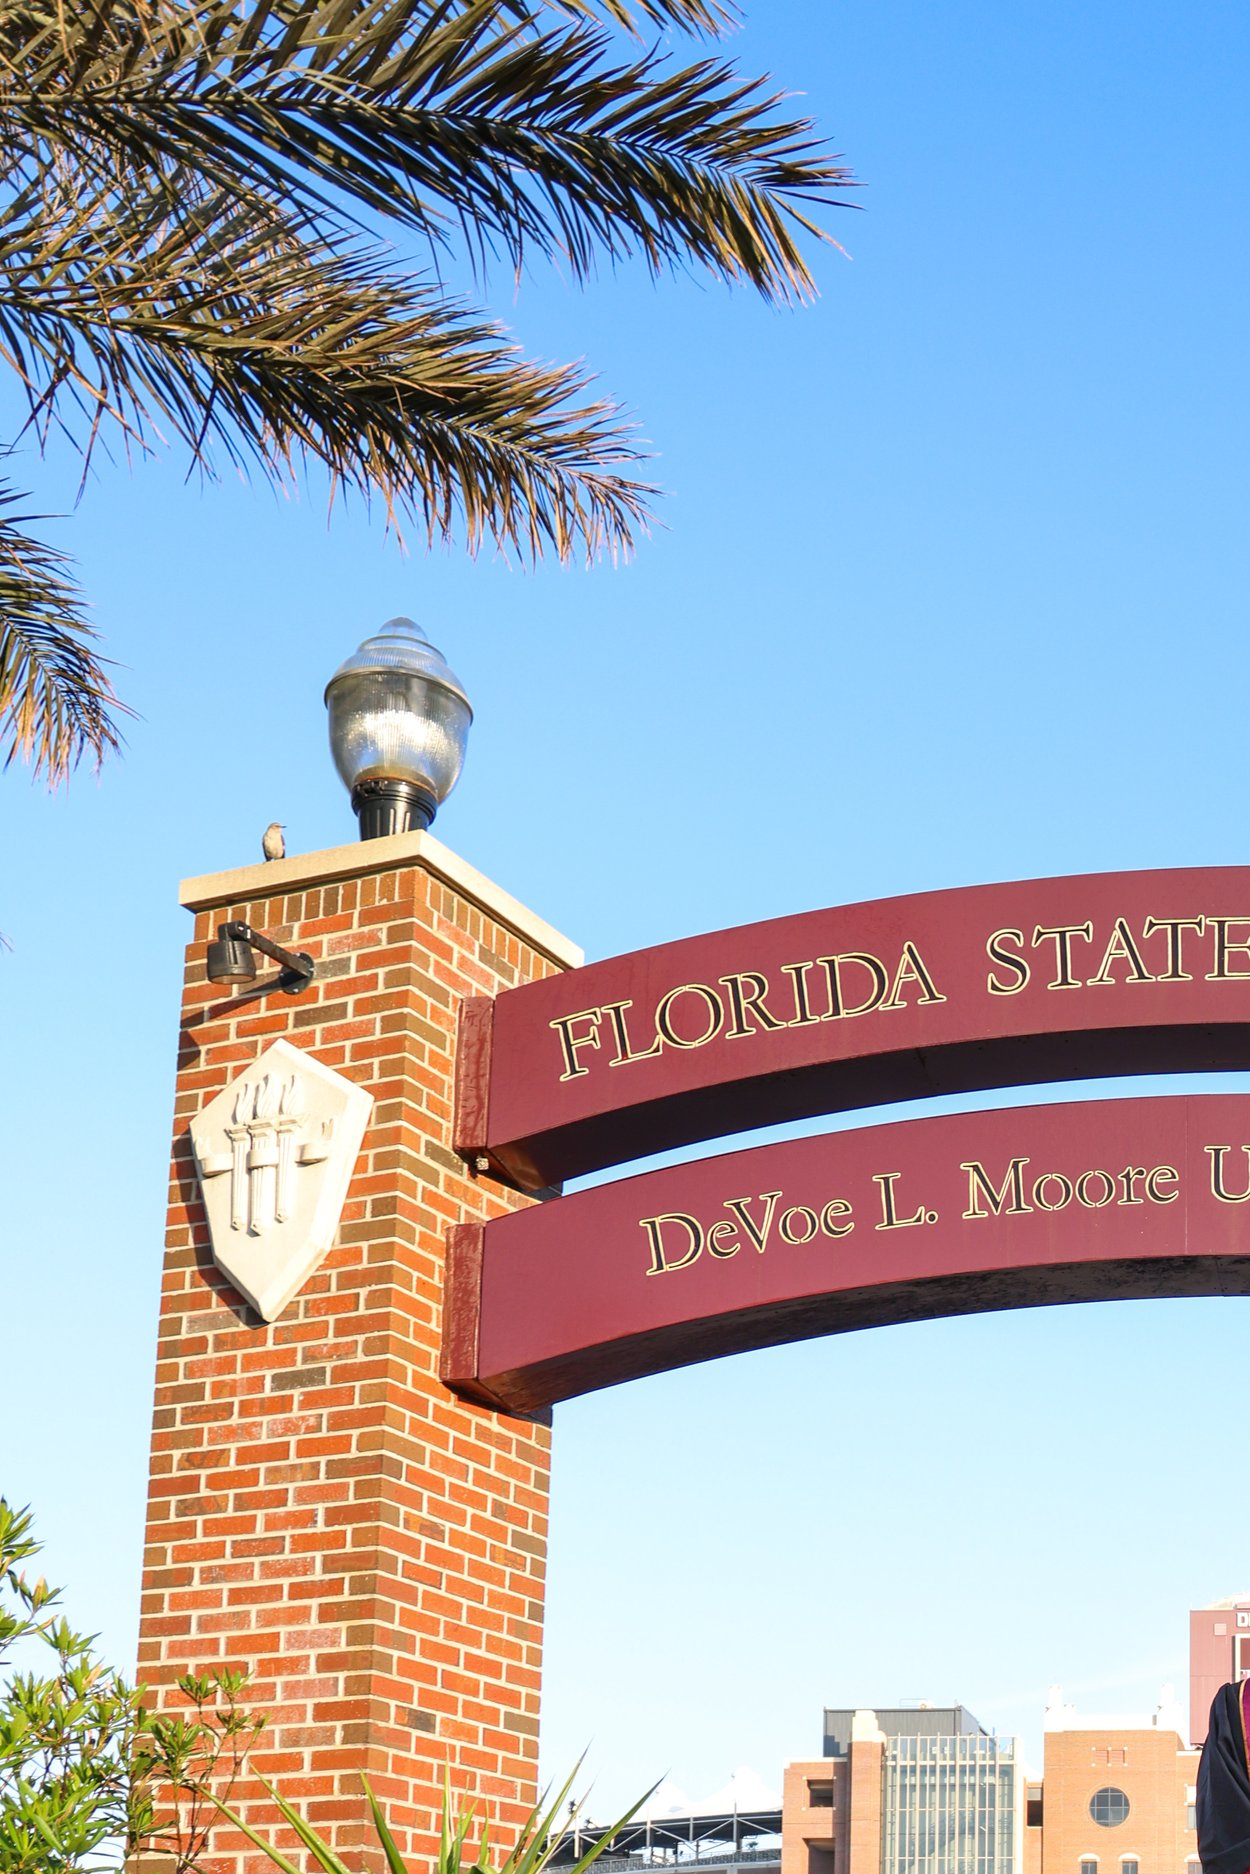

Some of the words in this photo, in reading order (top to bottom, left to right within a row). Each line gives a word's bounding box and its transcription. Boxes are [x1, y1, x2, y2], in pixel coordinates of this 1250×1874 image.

[550, 941, 946, 1081] FLORIDA
[639, 1190, 856, 1276] DeVoe
[872, 1172, 938, 1230] L.
[960, 1157, 1180, 1220] Moore
